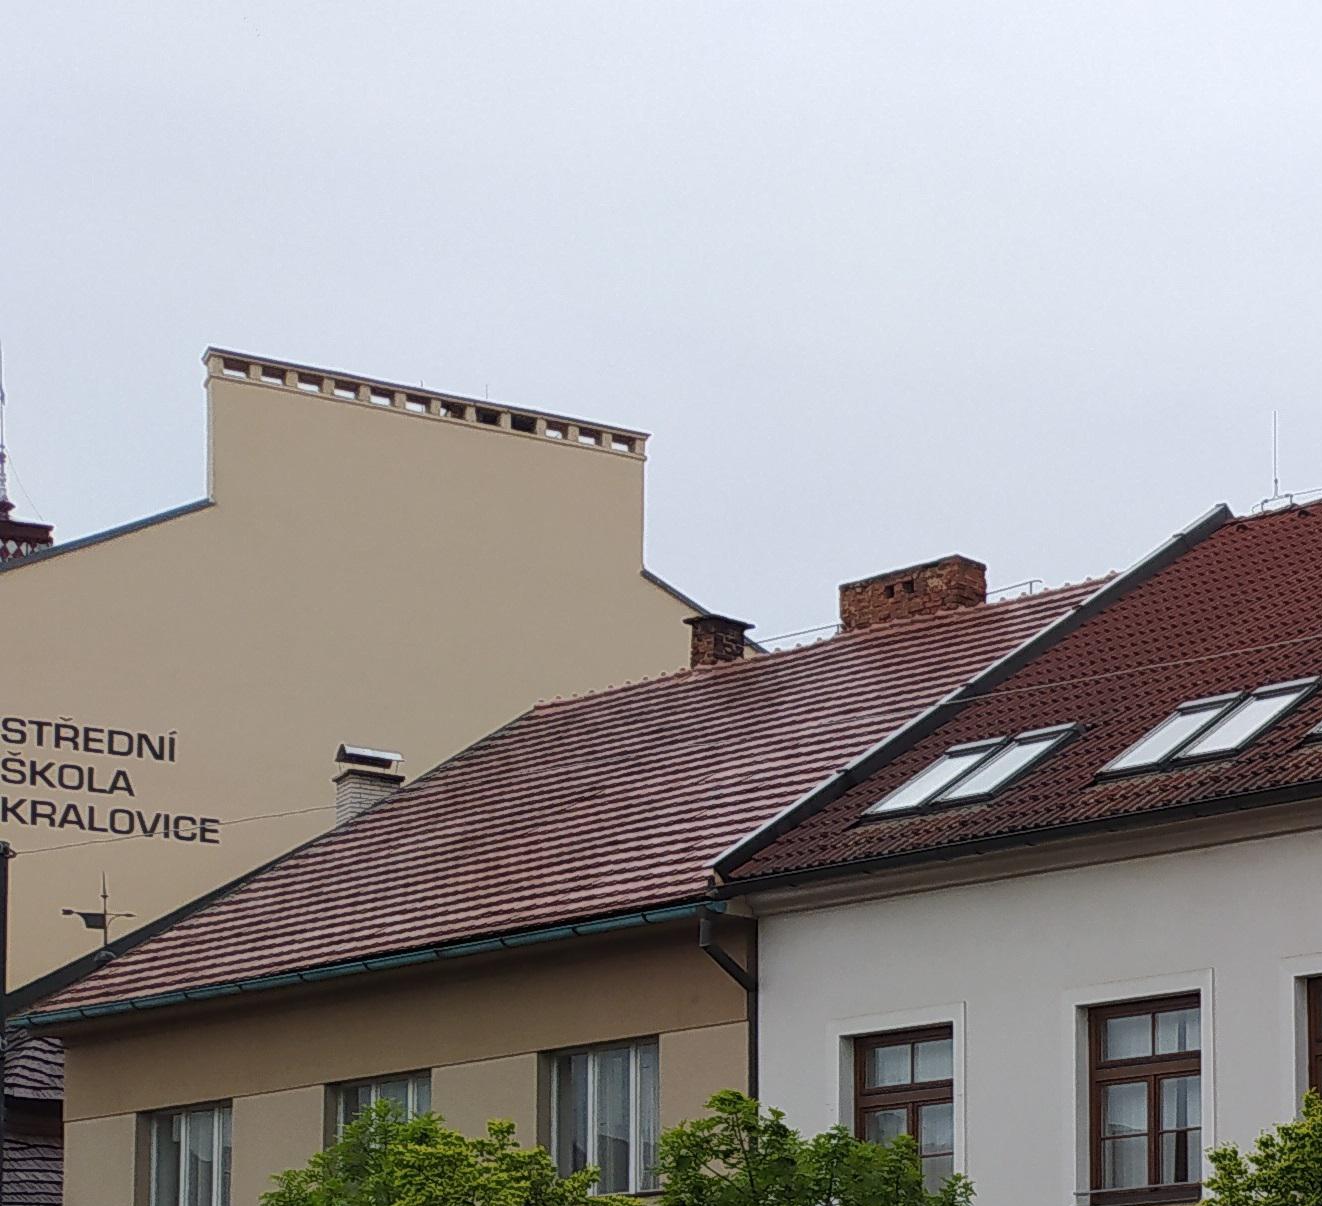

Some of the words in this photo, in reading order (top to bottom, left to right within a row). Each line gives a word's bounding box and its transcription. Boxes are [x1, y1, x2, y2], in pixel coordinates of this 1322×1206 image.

[1, 717, 178, 762] STŘEDNÍ
[1, 751, 135, 797] ŠKOLA
[1, 797, 220, 844] KRALOVICE
